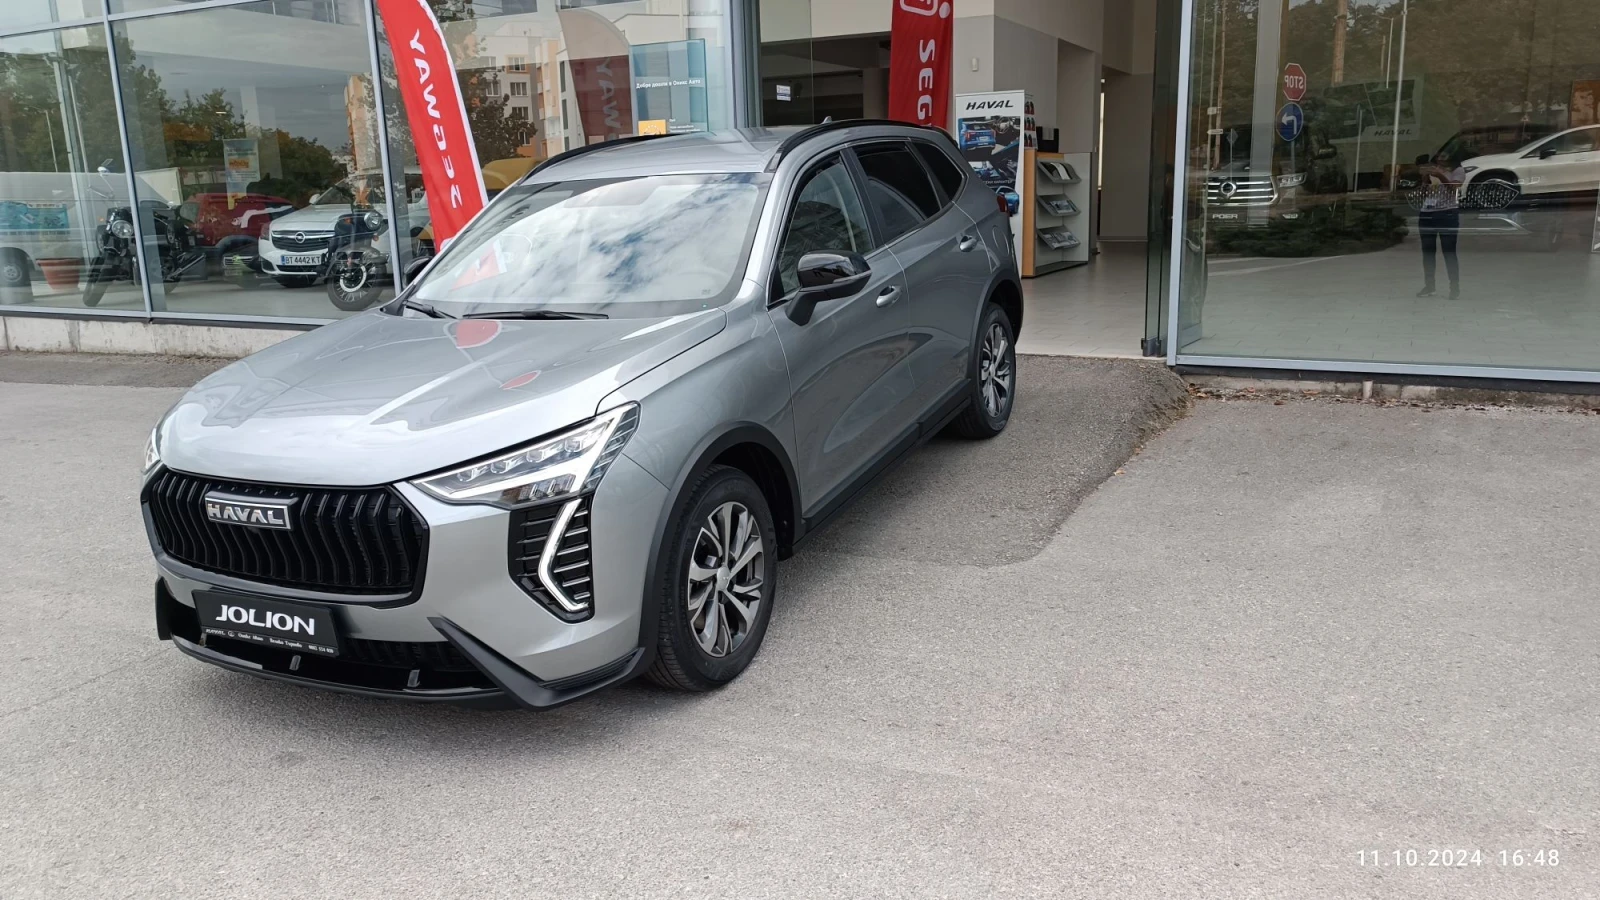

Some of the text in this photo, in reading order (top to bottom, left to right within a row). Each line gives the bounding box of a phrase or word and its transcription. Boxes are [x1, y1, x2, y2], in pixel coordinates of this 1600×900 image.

[917, 38, 936, 127] SEG
[965, 99, 1014, 111] HAVAL
[206, 503, 284, 525] HAVAL
[215, 604, 315, 636] JOLION
